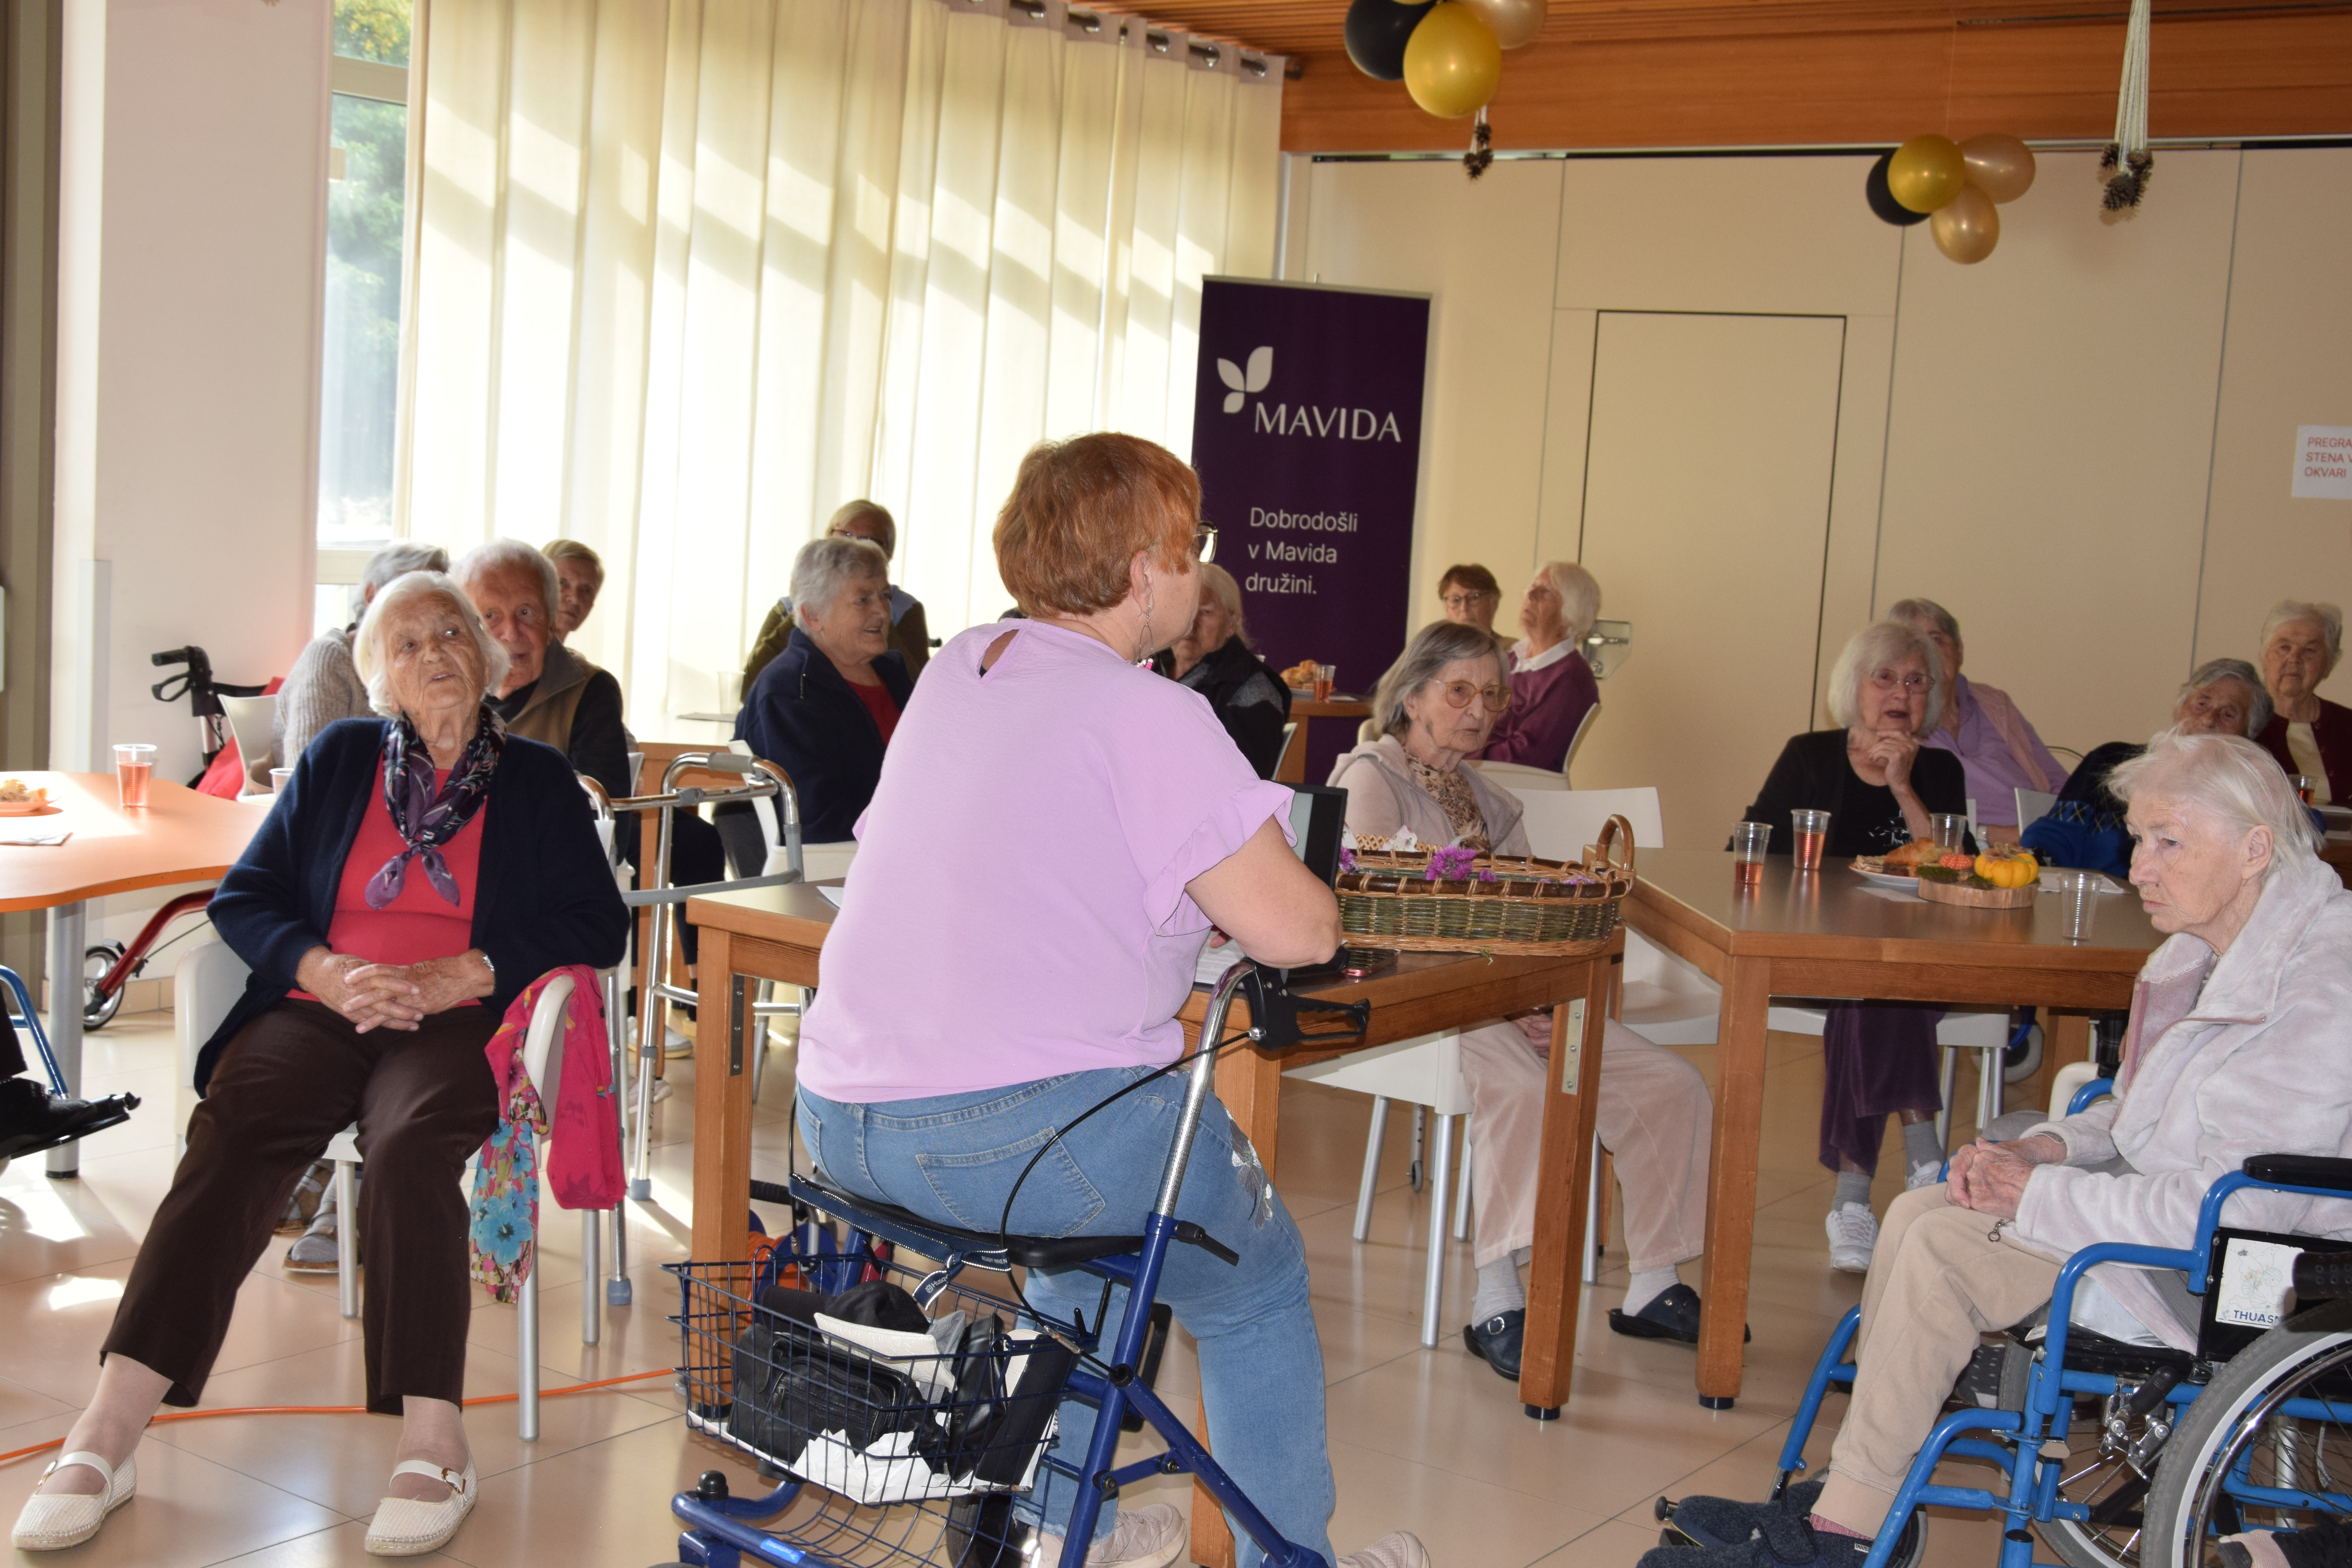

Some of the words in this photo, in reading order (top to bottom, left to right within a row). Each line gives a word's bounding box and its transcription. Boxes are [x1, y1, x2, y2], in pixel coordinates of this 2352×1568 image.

[1254, 401, 1401, 443] MAVIDA
[2308, 437, 2352, 448] PREGRA
[2306, 452, 2344, 462] STENA
[2305, 467, 2346, 477] OKVARI
[1250, 507, 1358, 532] Dobrodošli
[1248, 544, 1260, 559] v
[1265, 540, 1338, 564] Mavida
[1245, 572, 1317, 594] družini.
